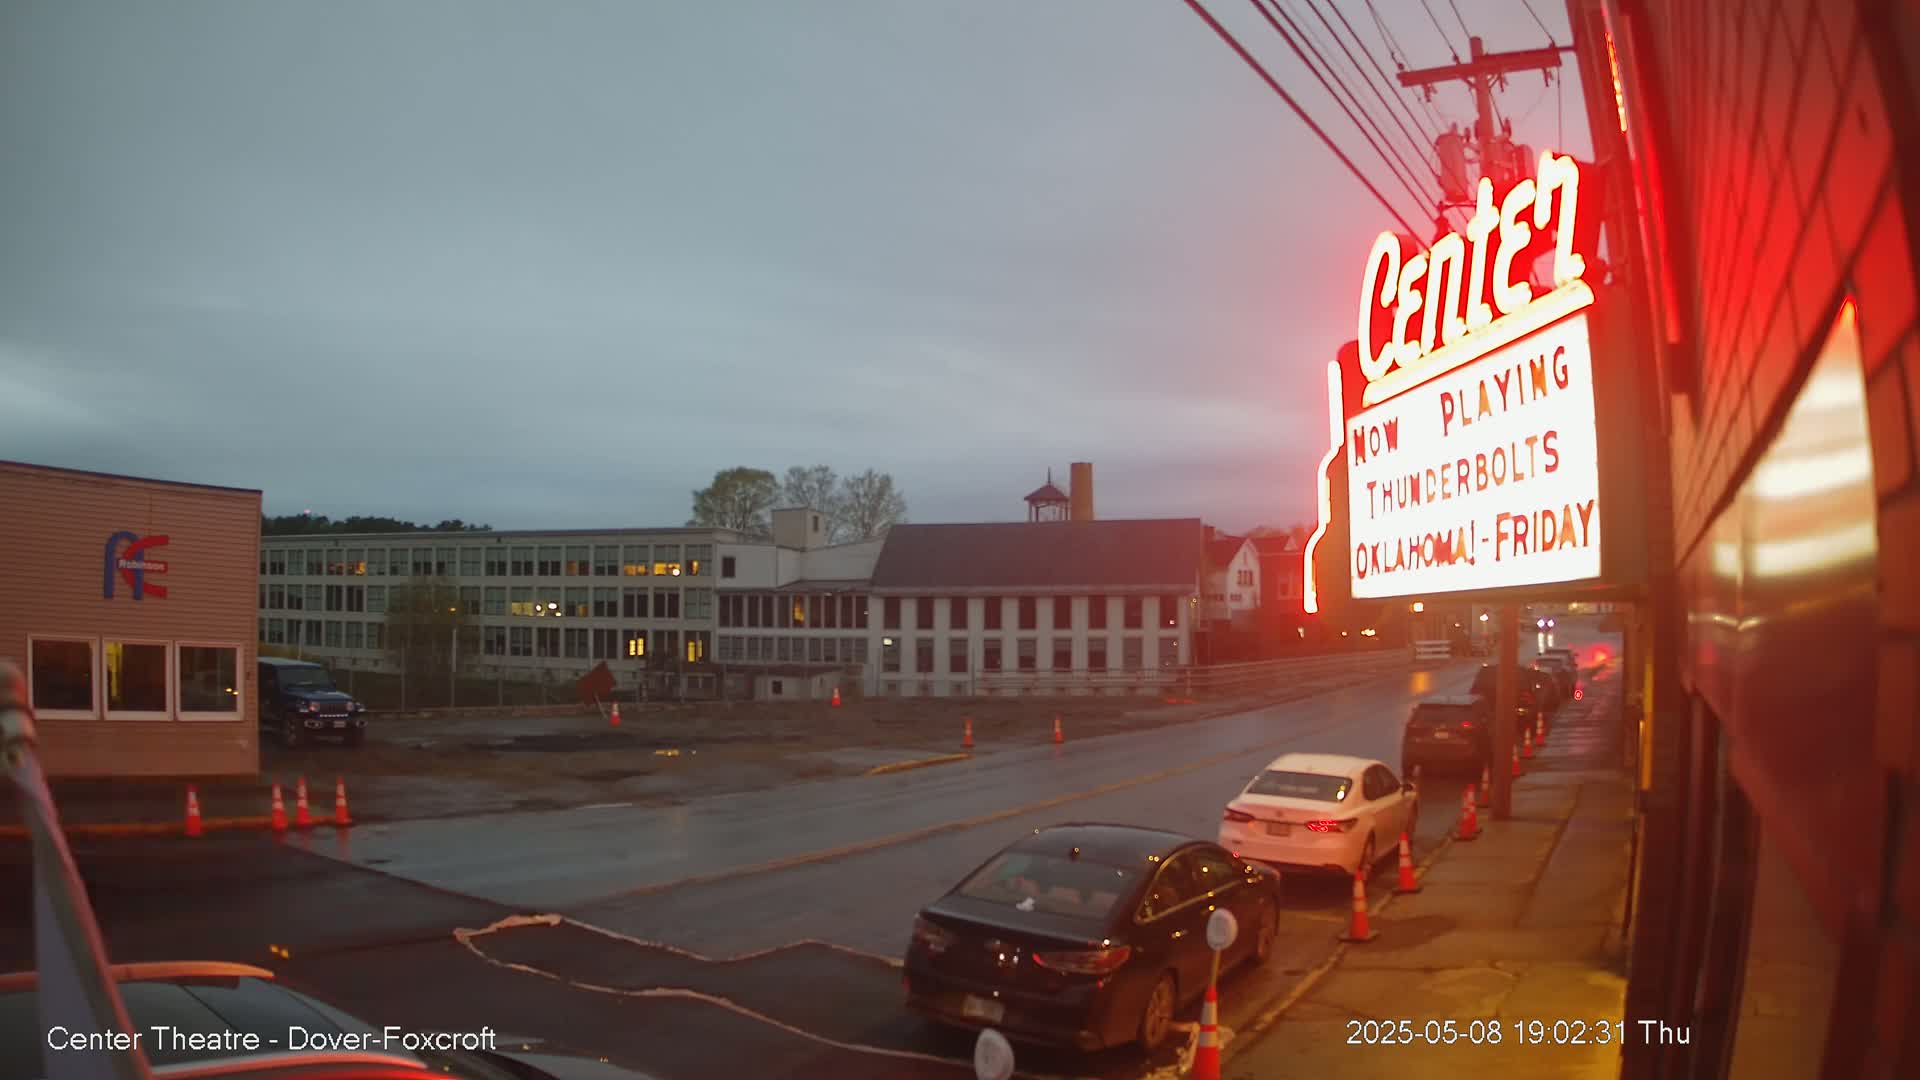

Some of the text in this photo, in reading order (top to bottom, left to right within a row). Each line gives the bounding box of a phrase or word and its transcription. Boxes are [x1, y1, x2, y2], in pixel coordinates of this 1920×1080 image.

[1358, 149, 1586, 382] Center
[1353, 346, 1569, 466] NOW PLAYING
[1366, 431, 1559, 519] THUNDERBOLTS
